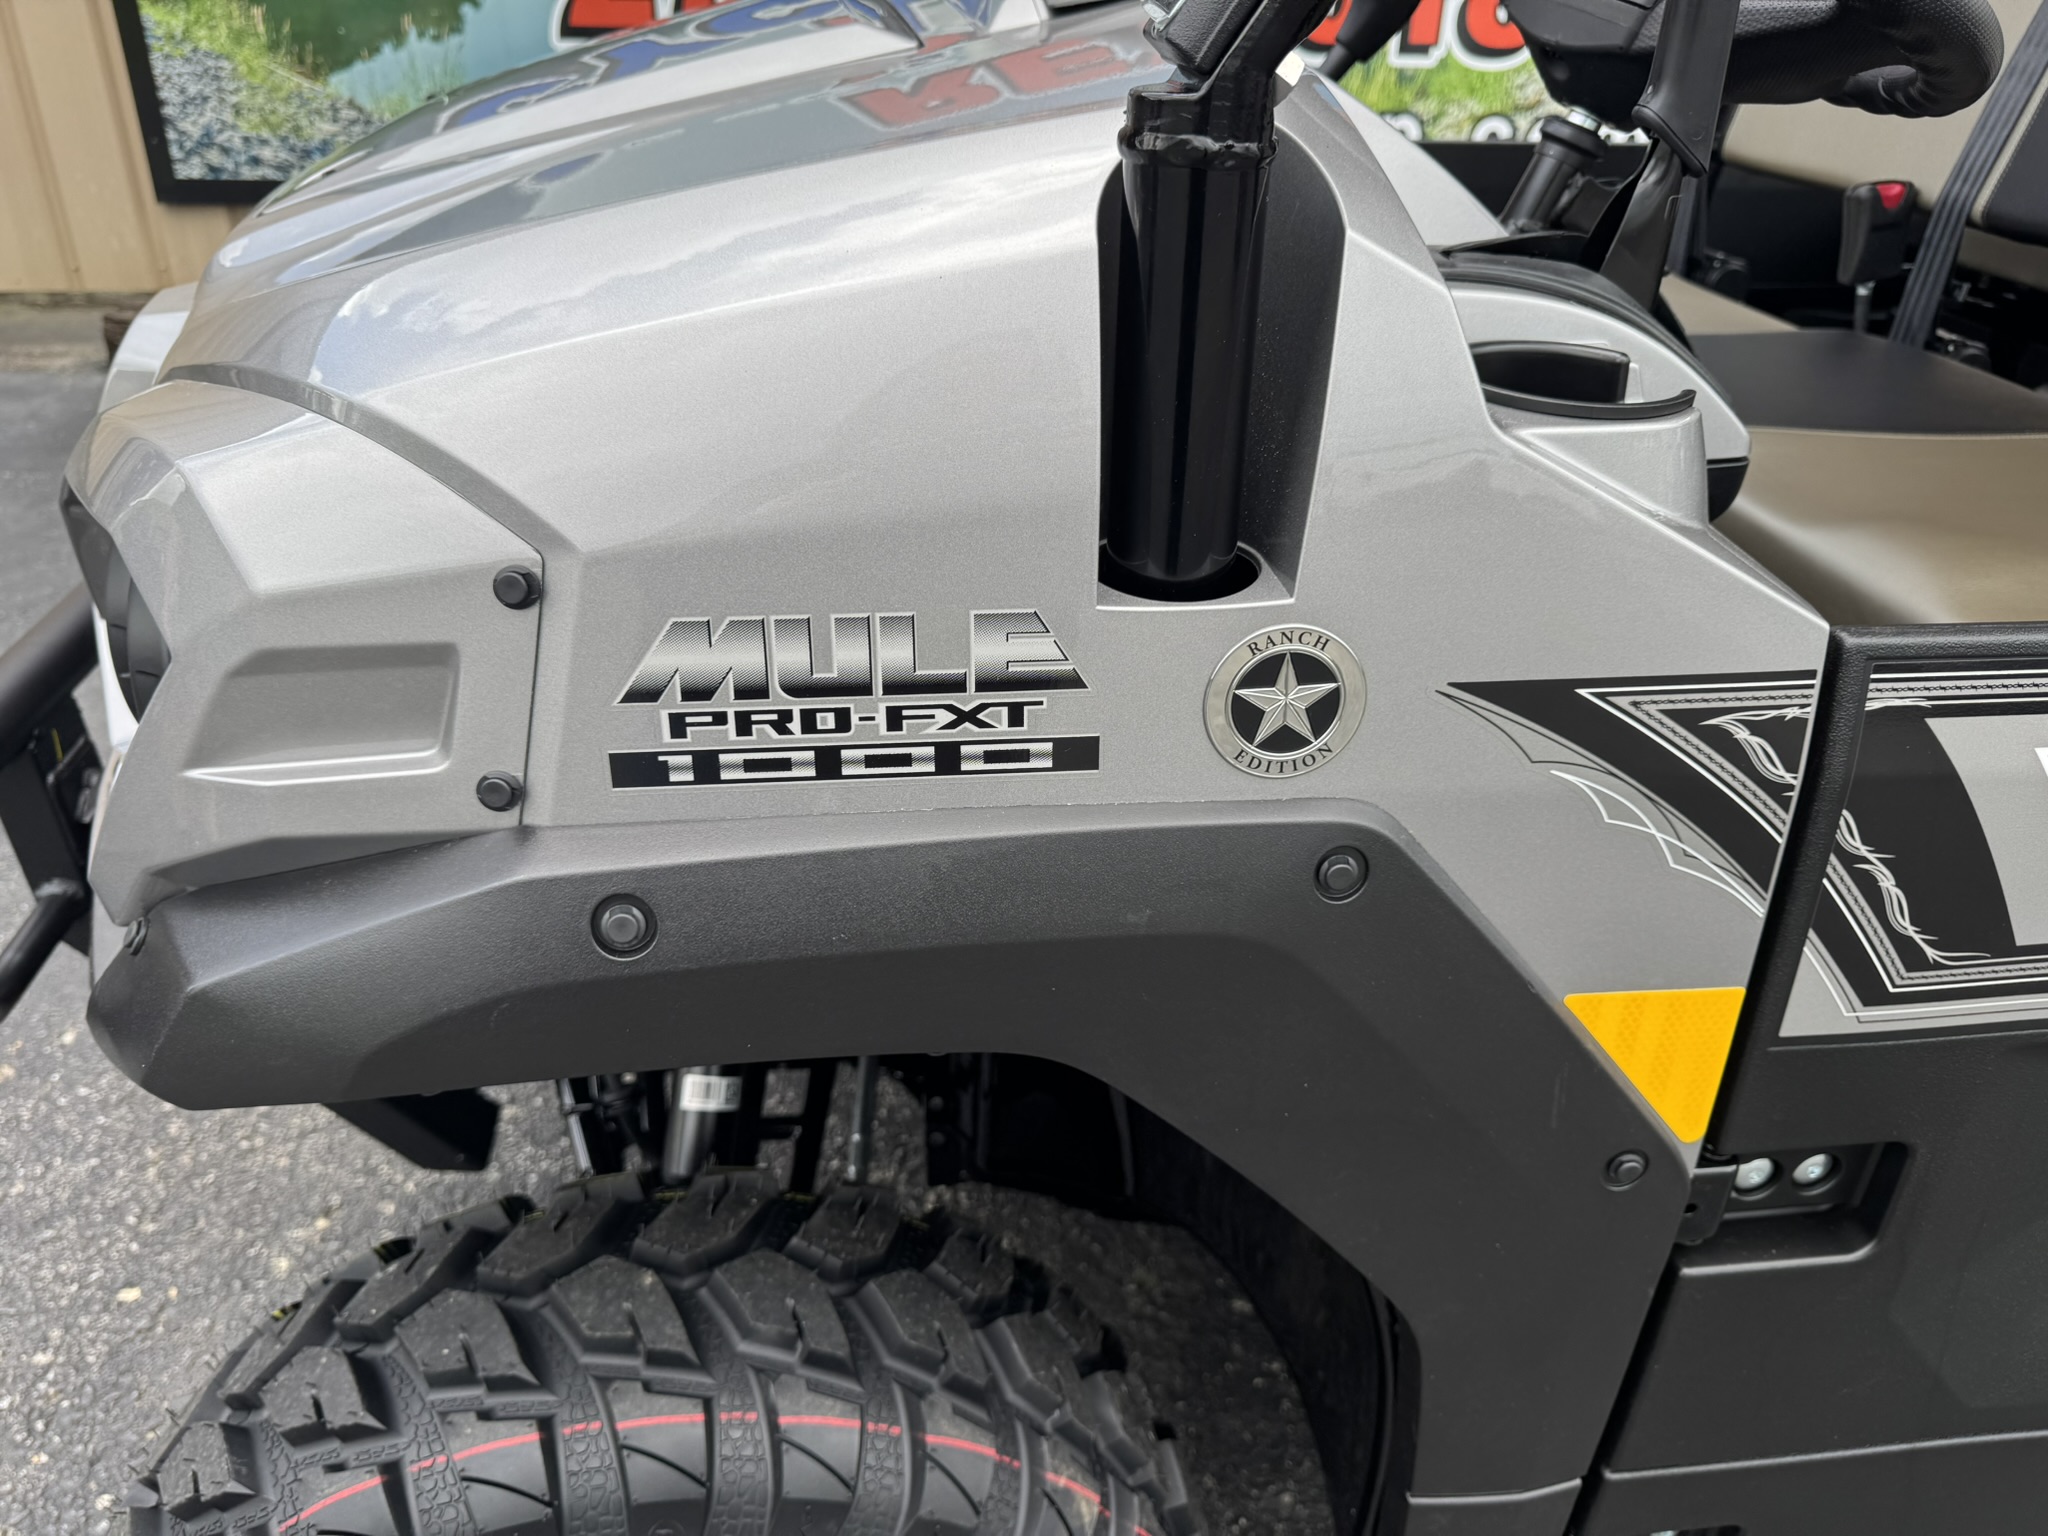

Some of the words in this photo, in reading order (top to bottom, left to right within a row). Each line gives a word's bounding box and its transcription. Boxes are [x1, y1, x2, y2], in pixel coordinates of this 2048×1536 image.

[614, 610, 1091, 704] MULE
[1247, 630, 1331, 656] RANCH
[666, 701, 1045, 739] PRO-FXT
[658, 741, 1053, 782] 1000
[1233, 743, 1333, 774] EDITION
